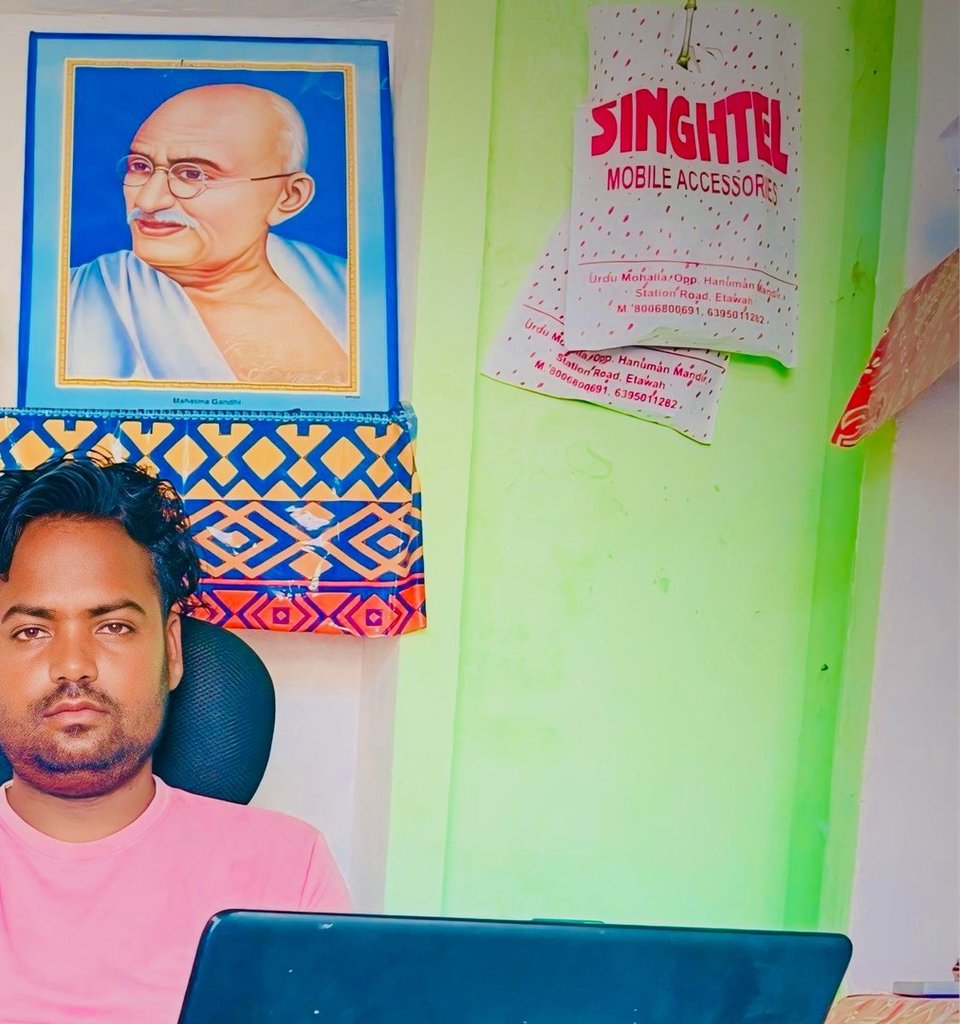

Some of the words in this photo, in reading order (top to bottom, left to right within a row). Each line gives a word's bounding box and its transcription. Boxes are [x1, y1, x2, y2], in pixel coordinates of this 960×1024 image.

[591, 87, 789, 174] SINGHTEL
[606, 165, 672, 191] MOBILE
[677, 169, 778, 206] ACCESSORIES
[589, 272, 618, 284] Urdu
[704, 276, 755, 289] Hanuman
[635, 288, 676, 298] Station
[716, 292, 753, 305] Etawah
[525, 318, 548, 337] Urdu
[618, 355, 670, 374] Hanuman
[556, 353, 591, 376] Station
[626, 374, 666, 390] Etawah
[614, 389, 678, 409] 6395011282
